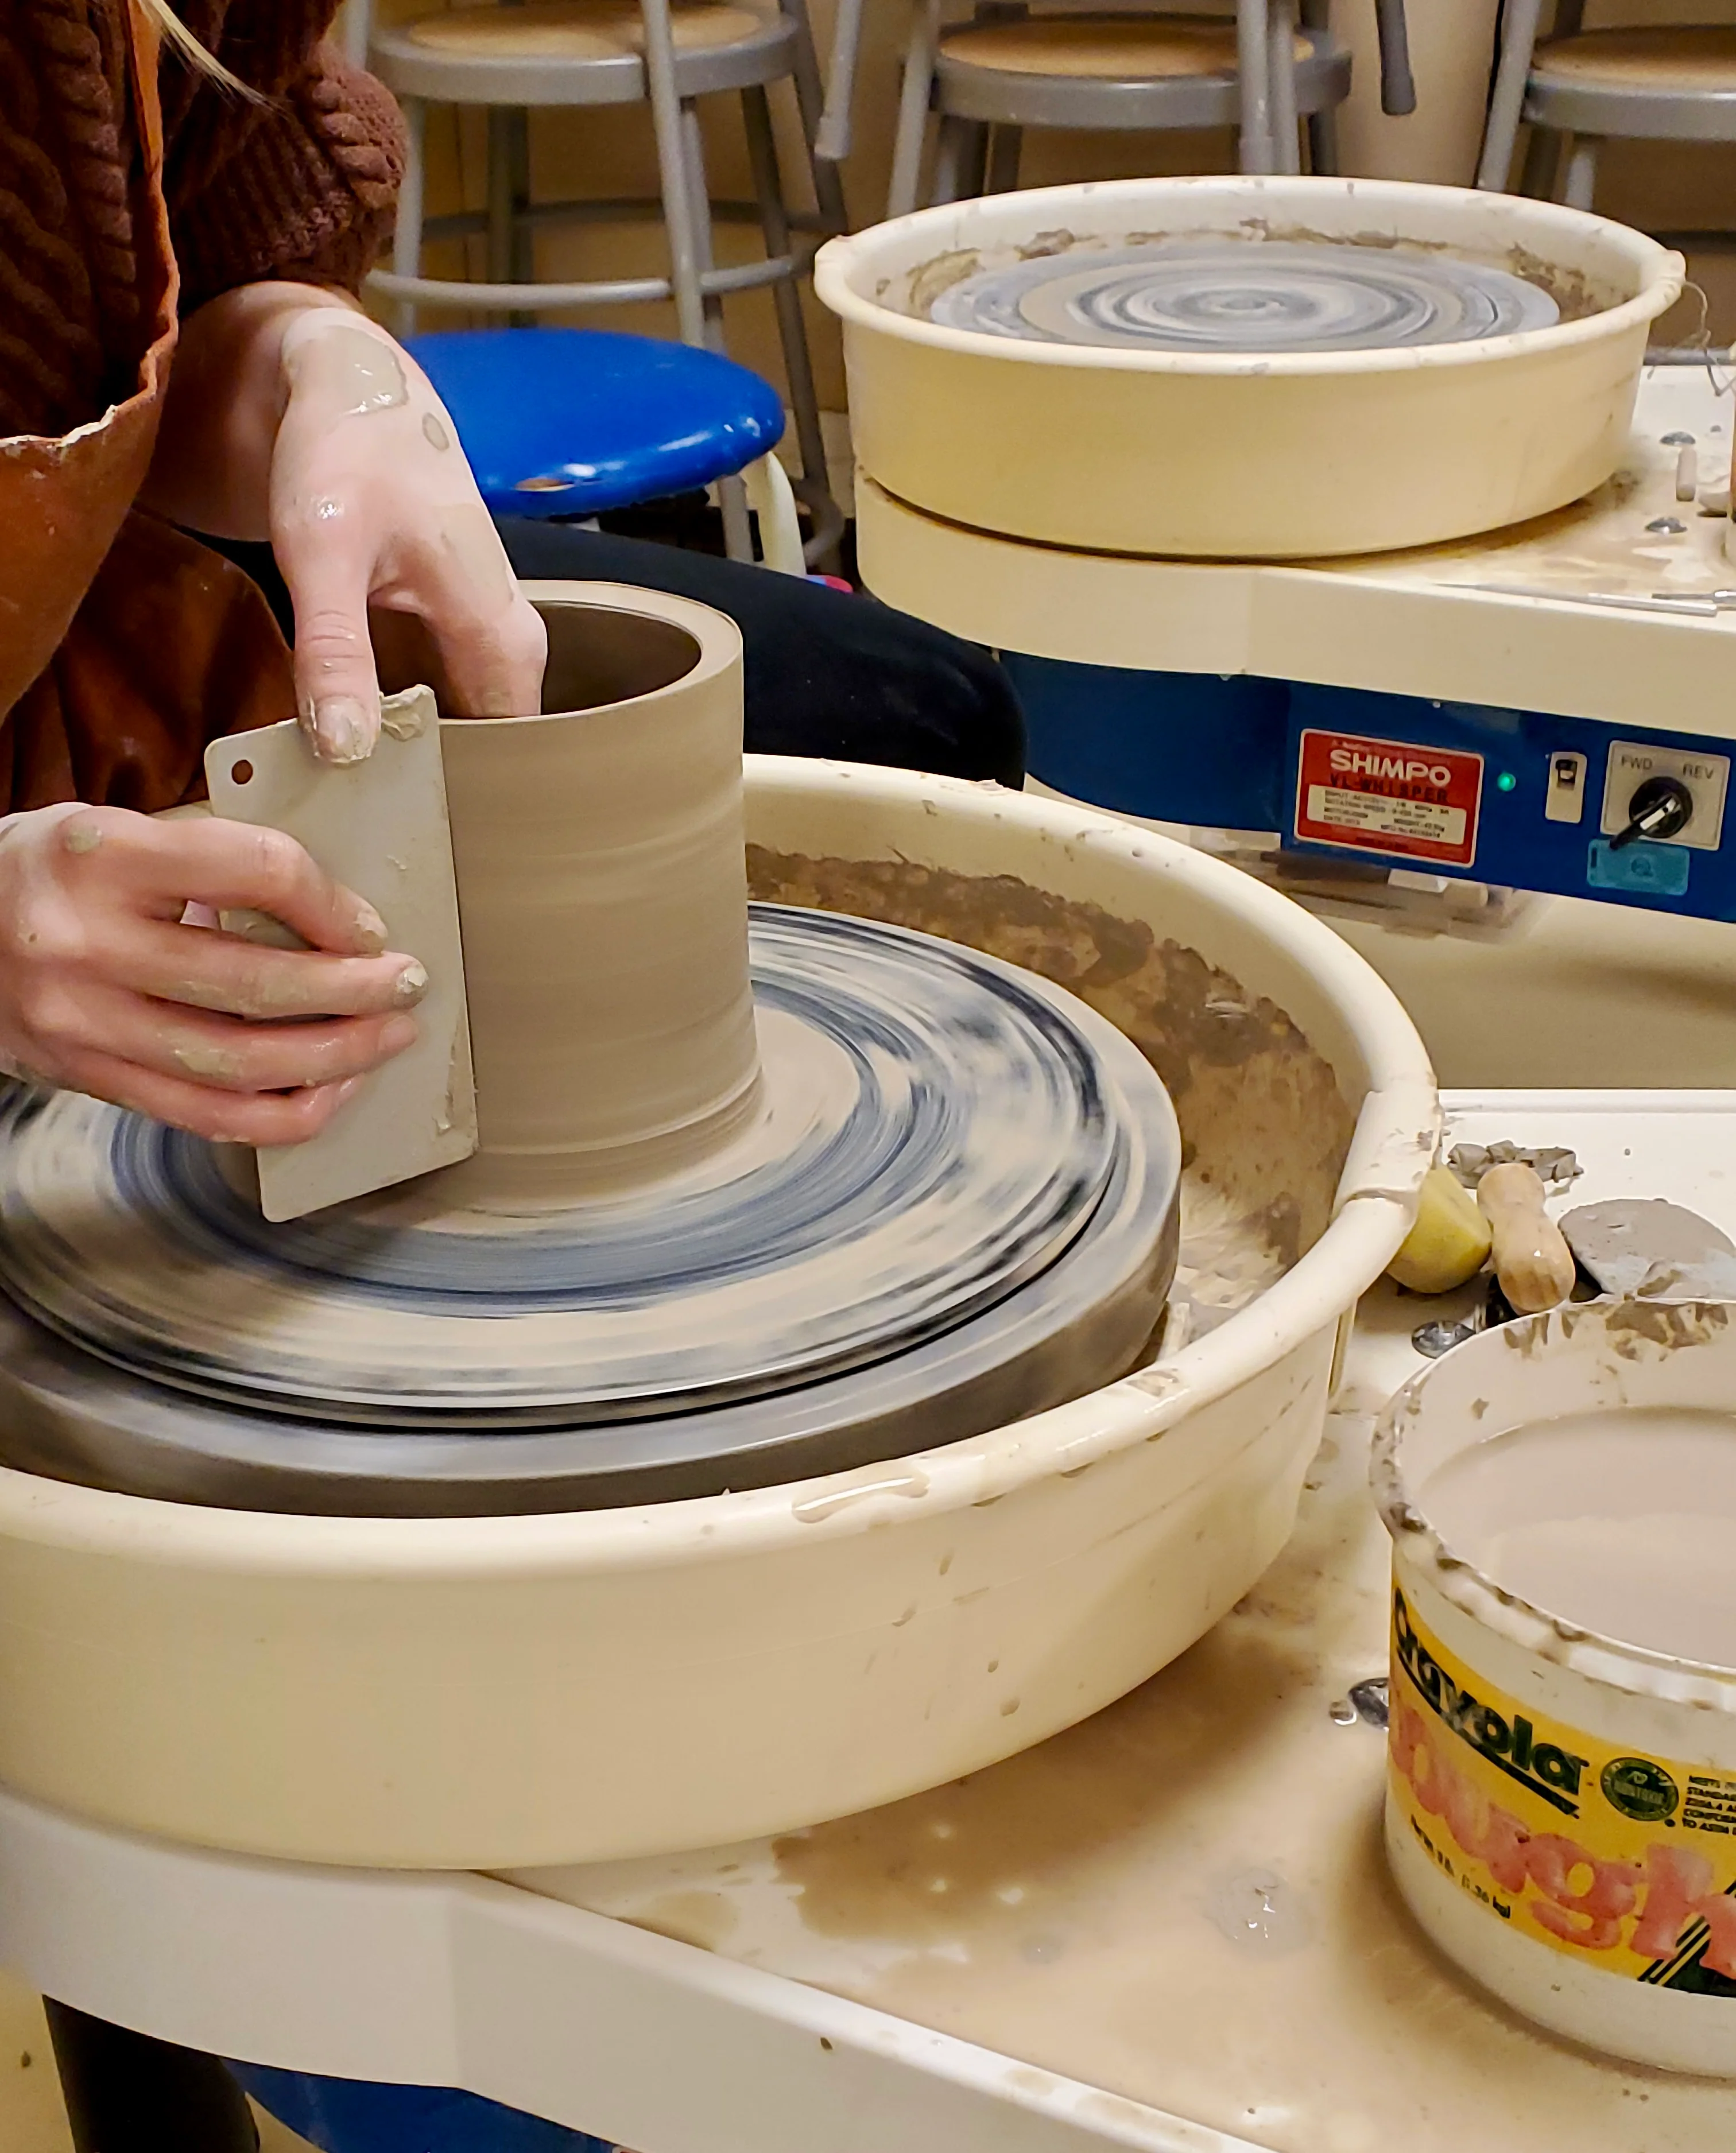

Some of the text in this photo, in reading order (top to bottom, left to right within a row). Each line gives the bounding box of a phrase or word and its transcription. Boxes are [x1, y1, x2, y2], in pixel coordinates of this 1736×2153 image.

[1330, 748, 1451, 787] SHIMPO
[1621, 754, 1715, 780] FWD REV
